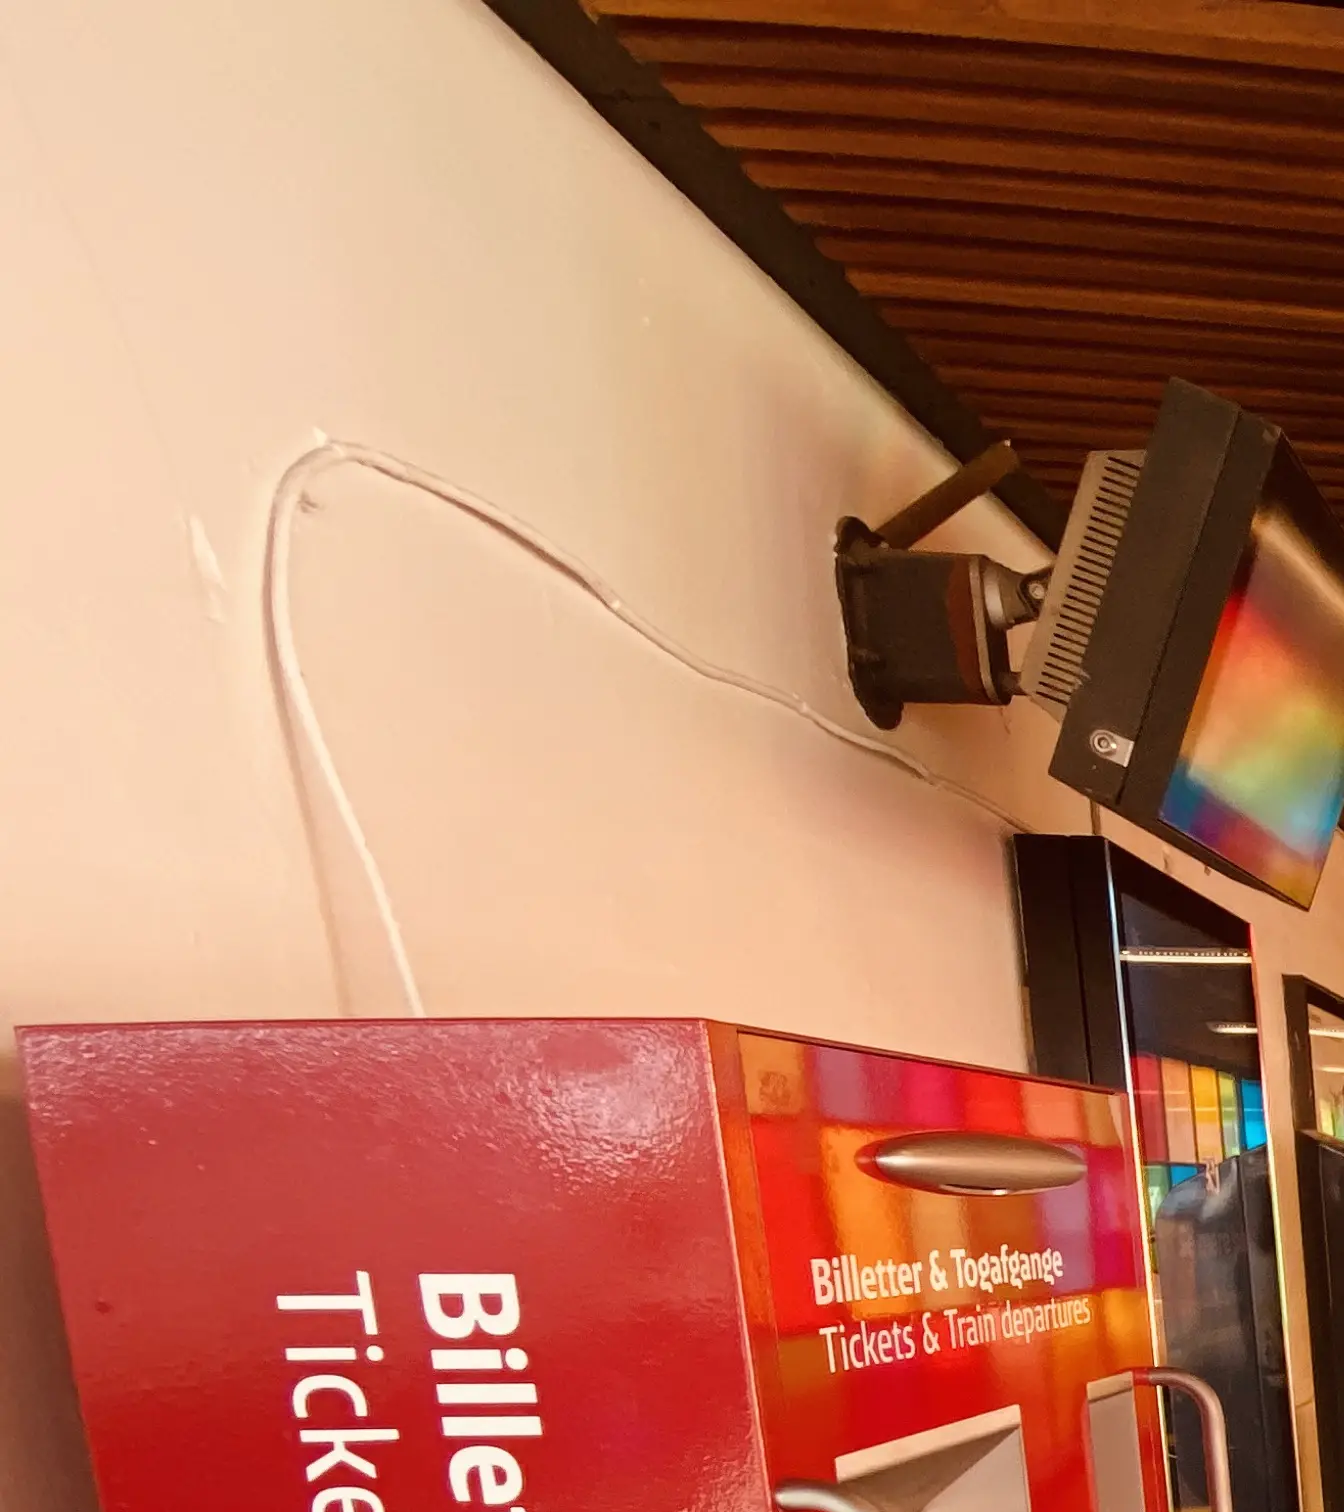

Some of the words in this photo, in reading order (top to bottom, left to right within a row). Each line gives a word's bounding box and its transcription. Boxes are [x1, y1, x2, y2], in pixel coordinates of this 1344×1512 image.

[809, 1254, 923, 1306] Billetter
[928, 1249, 949, 1293] &
[950, 1244, 1065, 1293] Togafgange
[818, 1320, 916, 1375] Tickets
[921, 1312, 941, 1355] &
[943, 1304, 998, 1350] Train
[1001, 1297, 1092, 1344] departures
